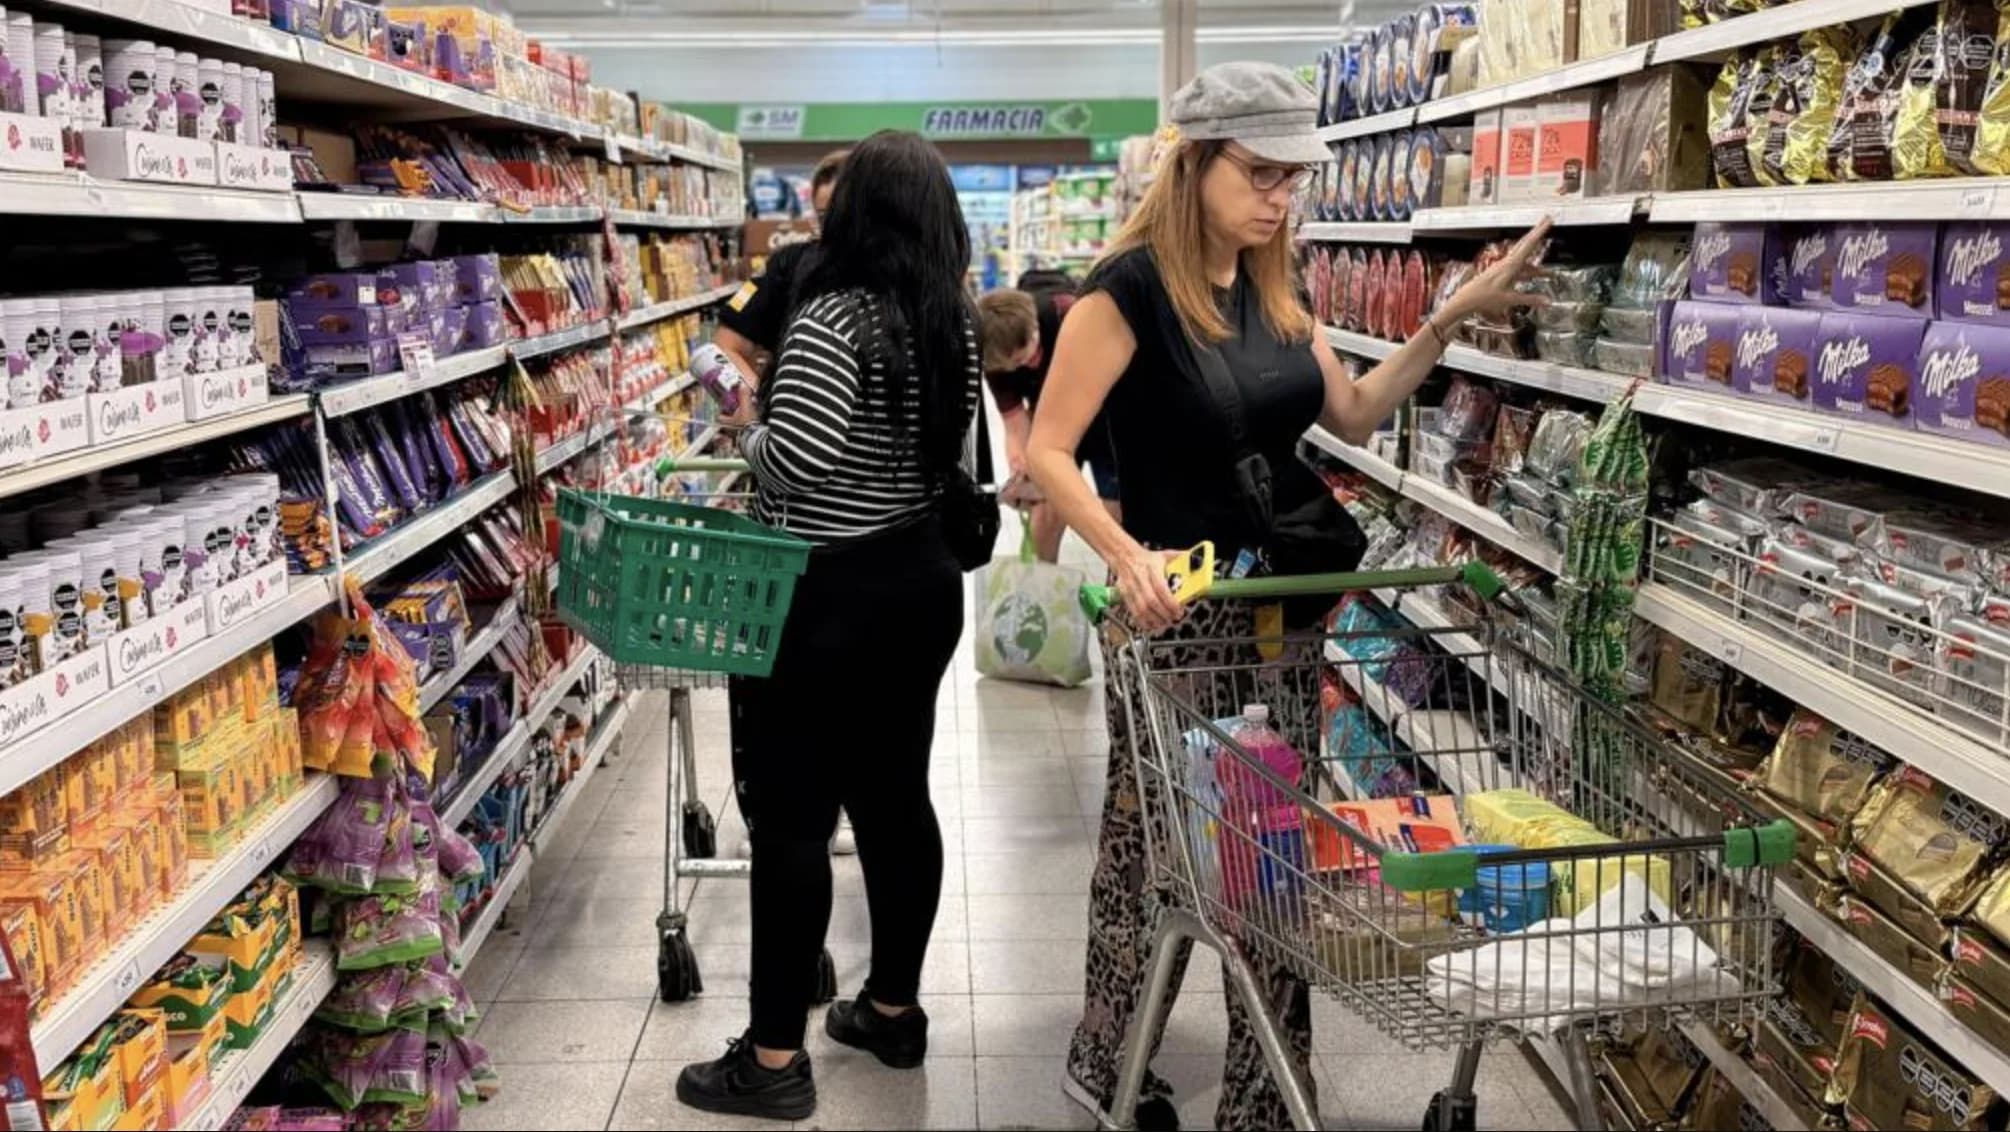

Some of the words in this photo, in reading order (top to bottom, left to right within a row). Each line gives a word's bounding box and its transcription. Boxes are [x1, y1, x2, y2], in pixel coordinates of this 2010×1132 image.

[925, 108, 1043, 131] FARMACIA
[1694, 232, 1731, 273] Milka
[1791, 232, 1826, 277] Milka
[1838, 229, 1889, 279] Milka
[1947, 229, 2002, 286] Milka
[1672, 322, 1708, 360] Milka
[1738, 325, 1779, 369] Milka
[1818, 336, 1871, 384] Milka
[1921, 345, 1981, 398] Milka
